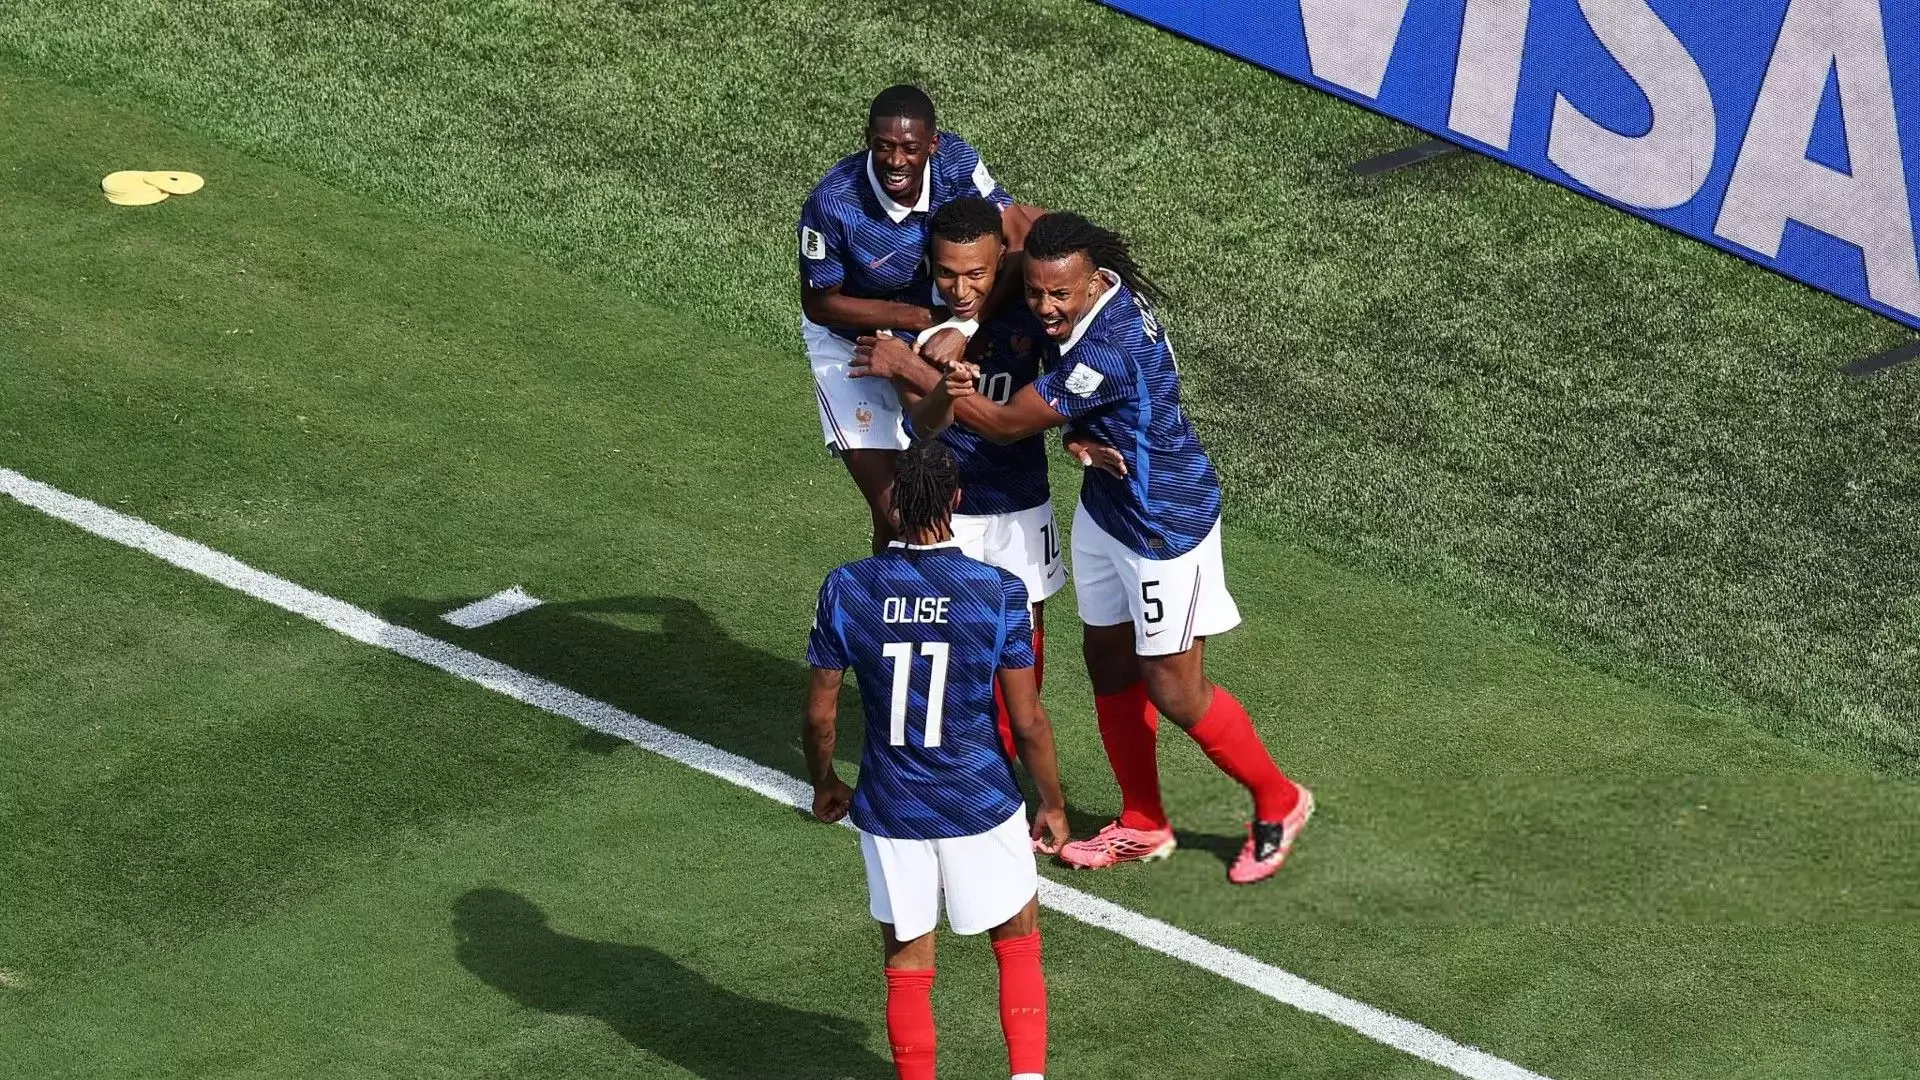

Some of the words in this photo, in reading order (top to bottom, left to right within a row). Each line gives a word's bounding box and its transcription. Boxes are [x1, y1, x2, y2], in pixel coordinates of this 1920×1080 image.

[882, 596, 951, 624] OLISE
[1141, 580, 1164, 623] 5
[882, 642, 950, 748] 11
